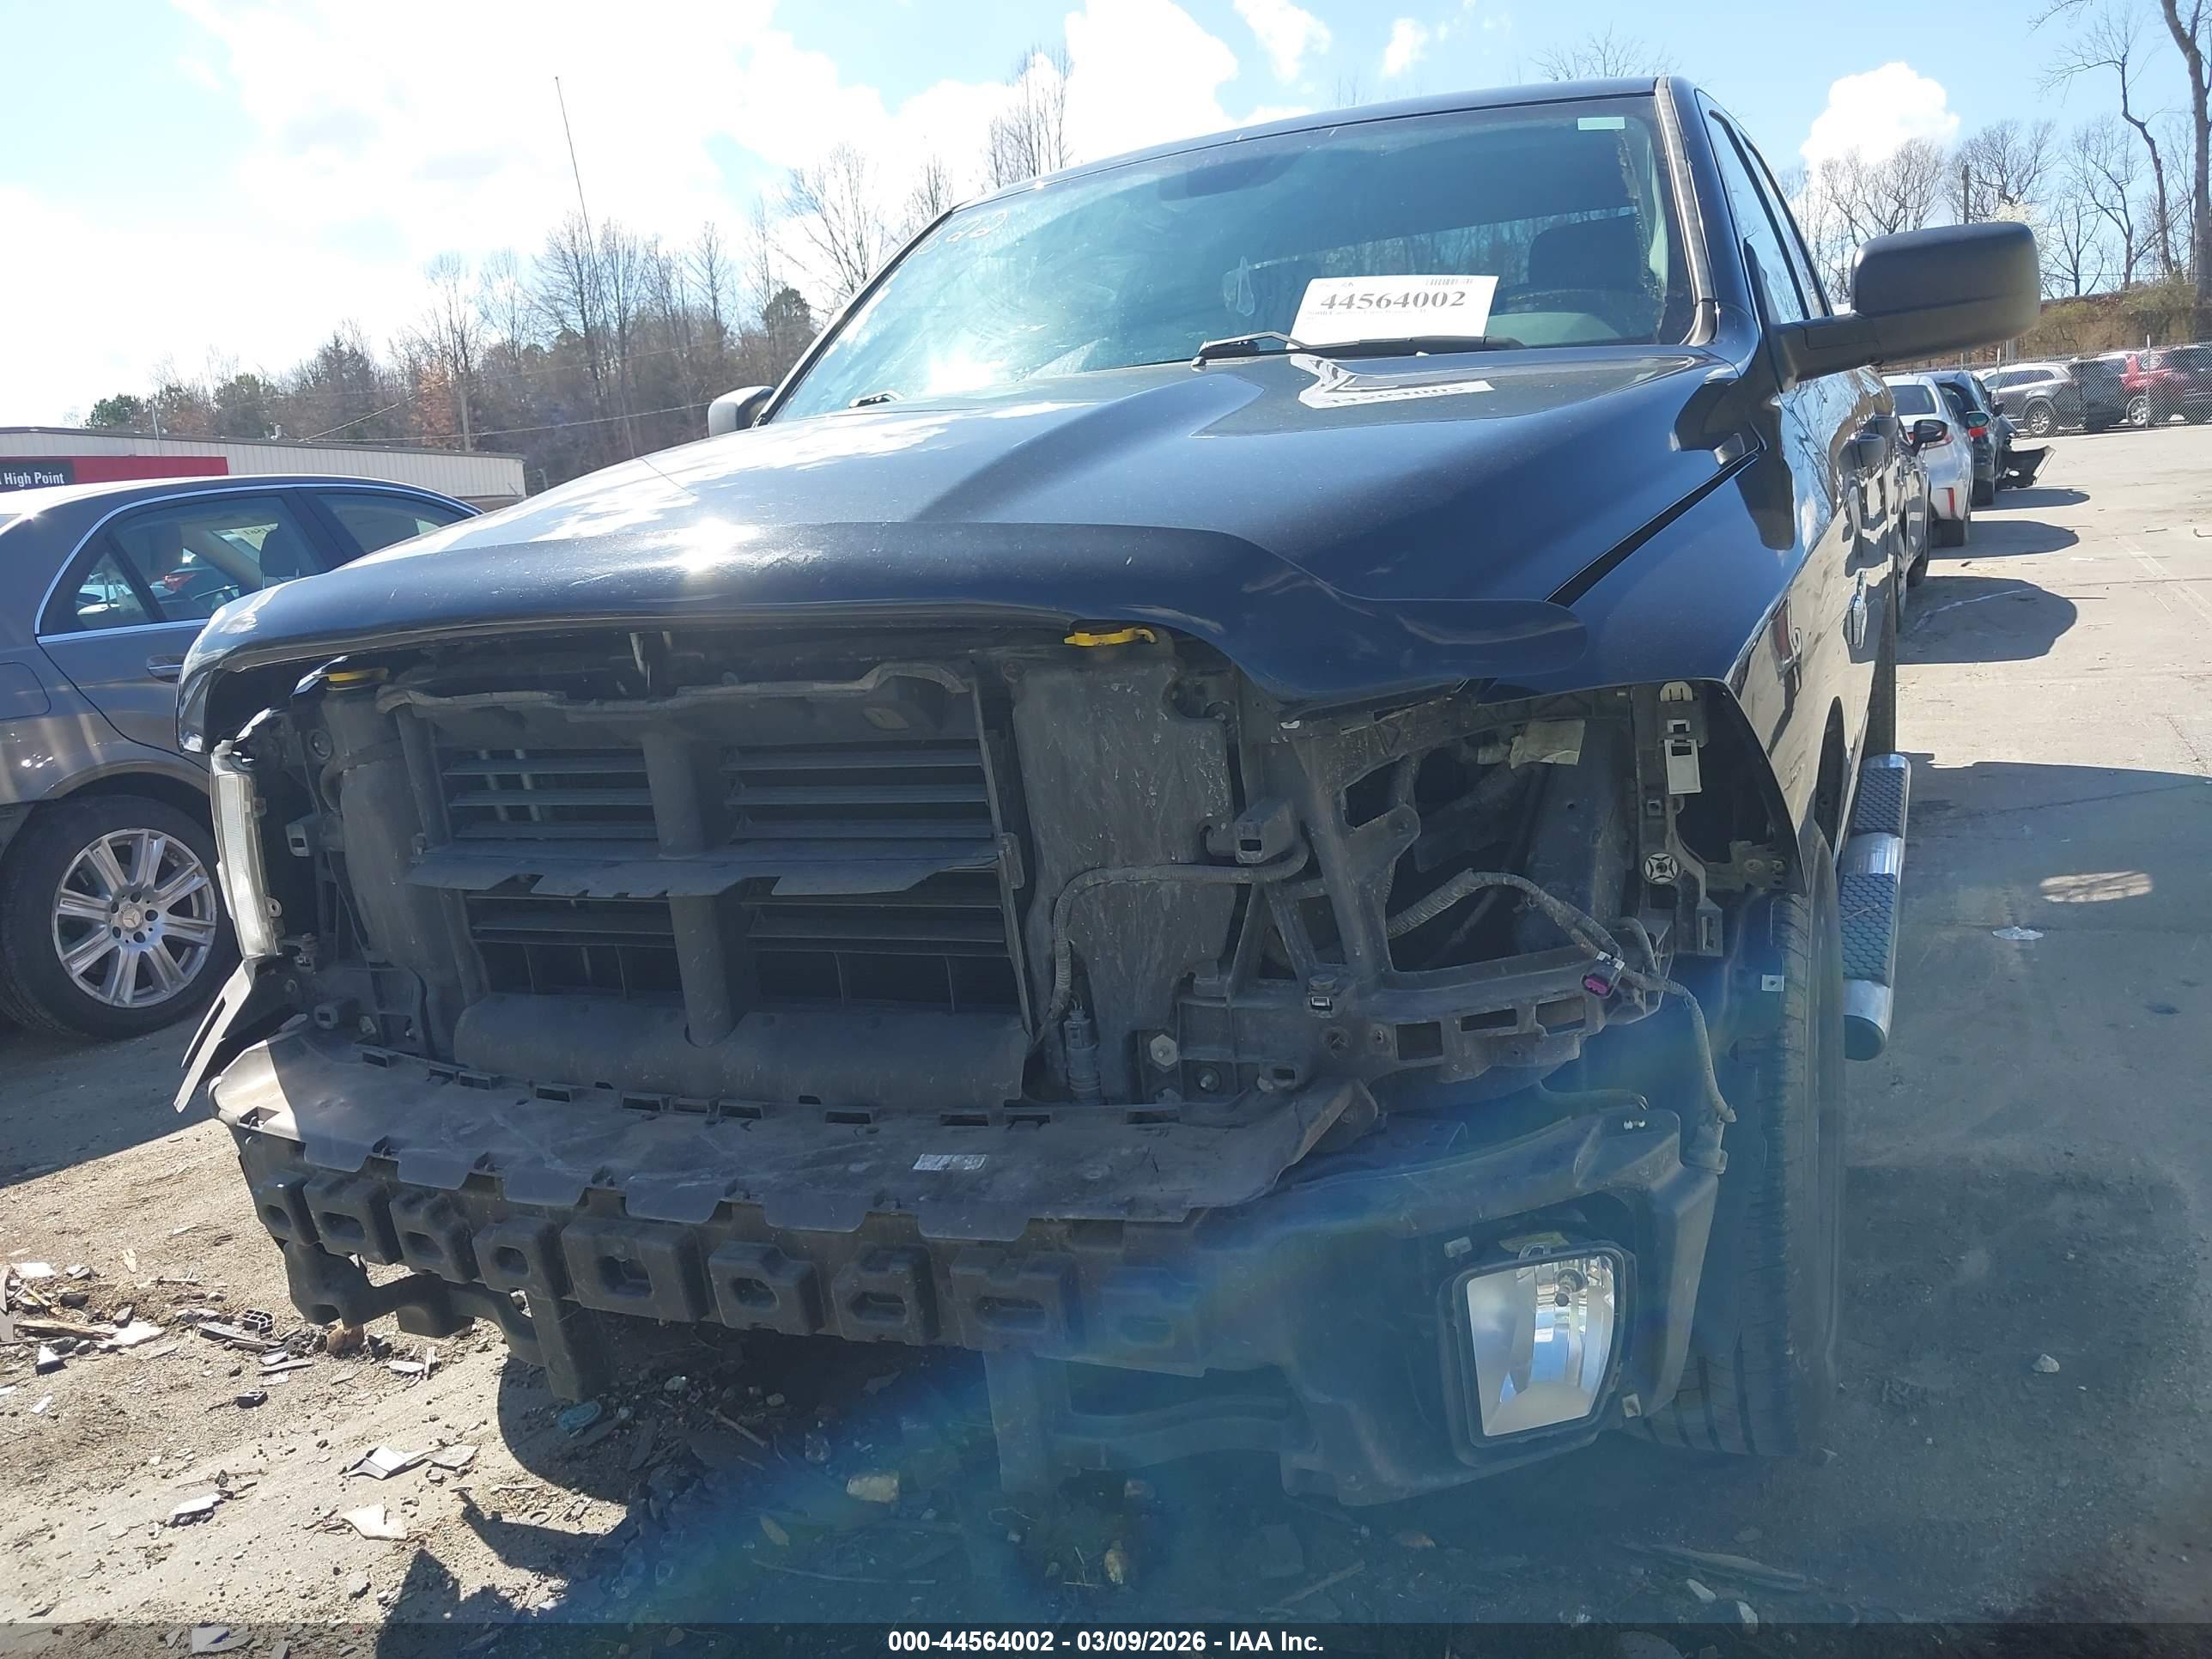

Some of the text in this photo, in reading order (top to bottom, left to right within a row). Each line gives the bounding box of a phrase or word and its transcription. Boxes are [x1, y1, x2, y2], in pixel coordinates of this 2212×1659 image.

[1320, 290, 1467, 310] 44564002
[3, 471, 65, 488] High Point
